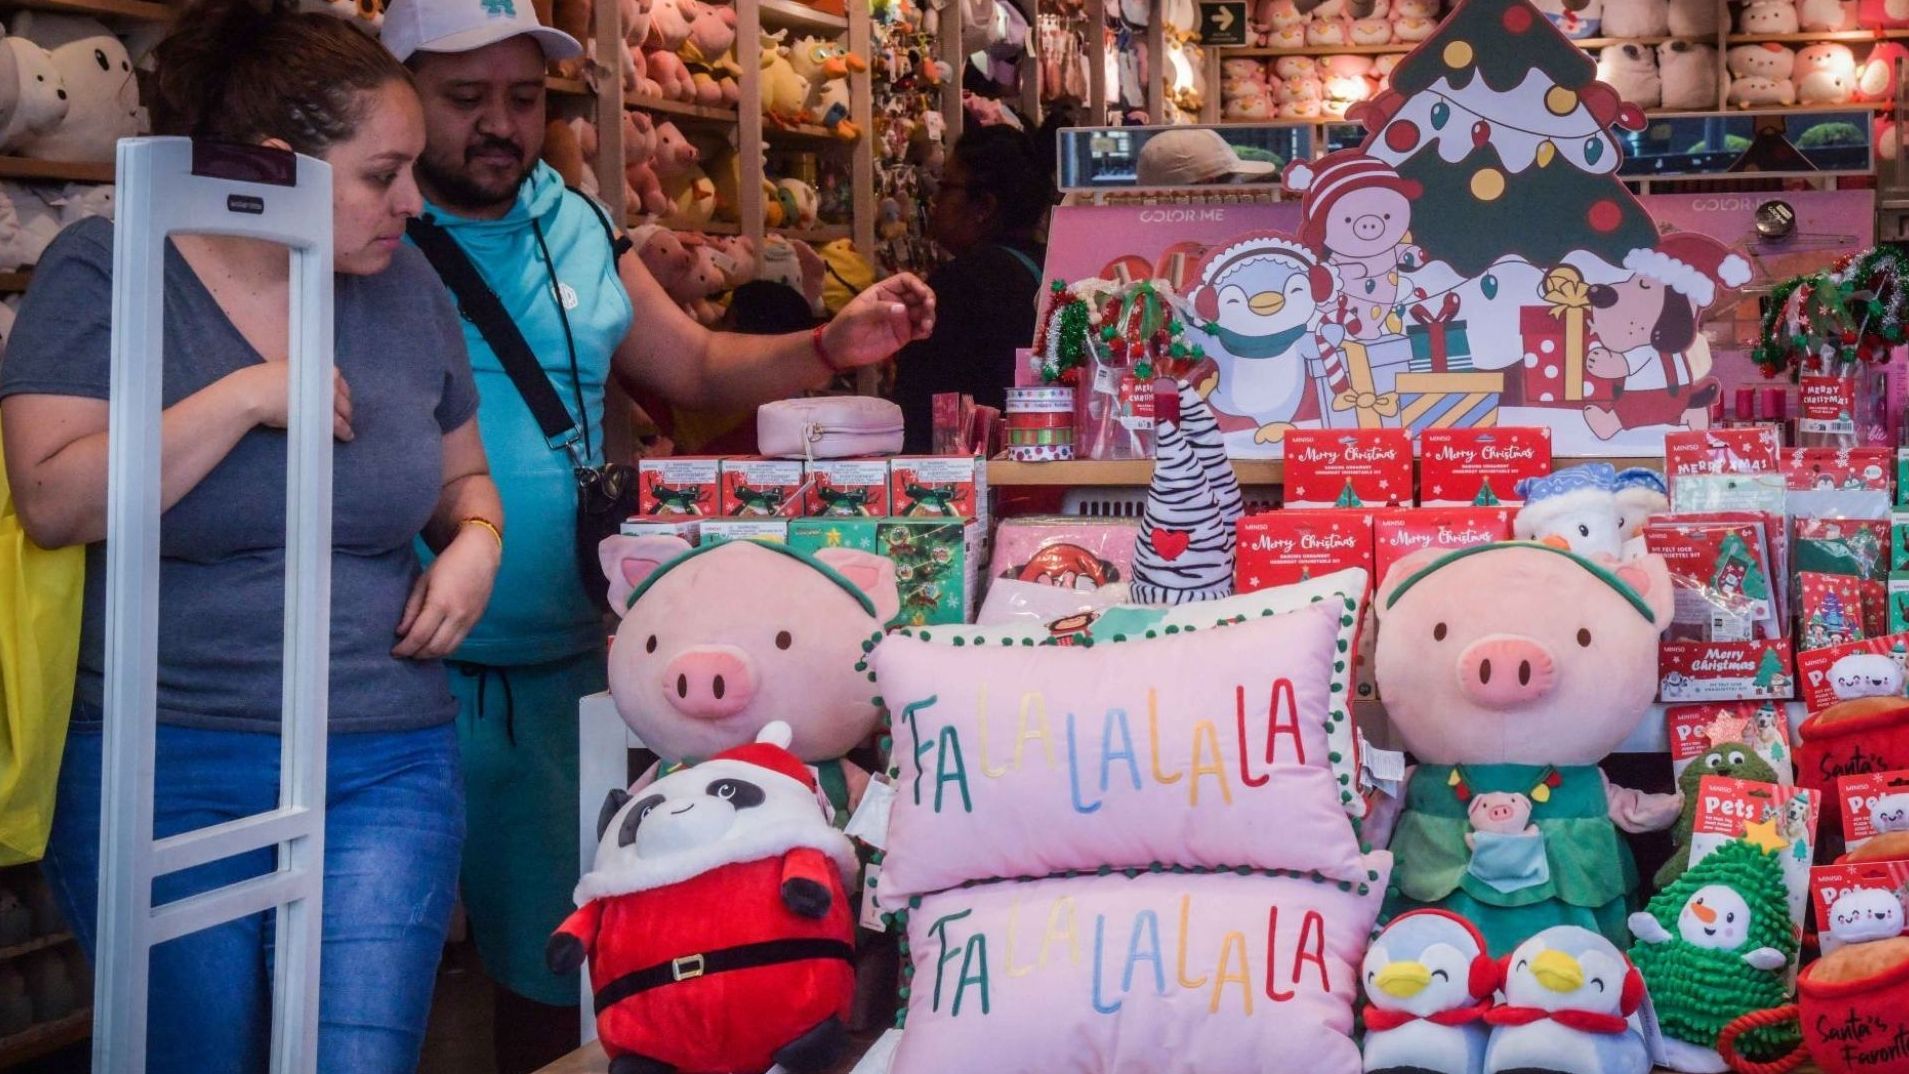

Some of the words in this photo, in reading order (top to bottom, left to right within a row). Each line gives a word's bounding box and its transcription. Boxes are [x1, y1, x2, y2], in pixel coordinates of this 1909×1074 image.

[1140, 209, 1195, 222] COLOR
[1200, 208, 1225, 221] ME
[1298, 446, 1339, 464] Merry
[1344, 447, 1397, 461] Christmas
[1435, 445, 1477, 463] Merry
[1481, 445, 1535, 461] Christmas
[1673, 444, 1699, 452] MINISO
[1252, 534, 1296, 552] Merry
[1300, 534, 1356, 549] Christmas
[1390, 530, 1434, 547] Merry
[1438, 528, 1493, 544] Christmas
[1704, 648, 1744, 661] Merry
[1691, 659, 1756, 672] Christmas
[1676, 724, 1706, 741] Pe
[902, 694, 973, 813] FA
[1820, 745, 1889, 782] Santa's
[1704, 796, 1755, 820] Pets
[928, 908, 989, 1016] FA
[1816, 1006, 1889, 1044] Santa's
